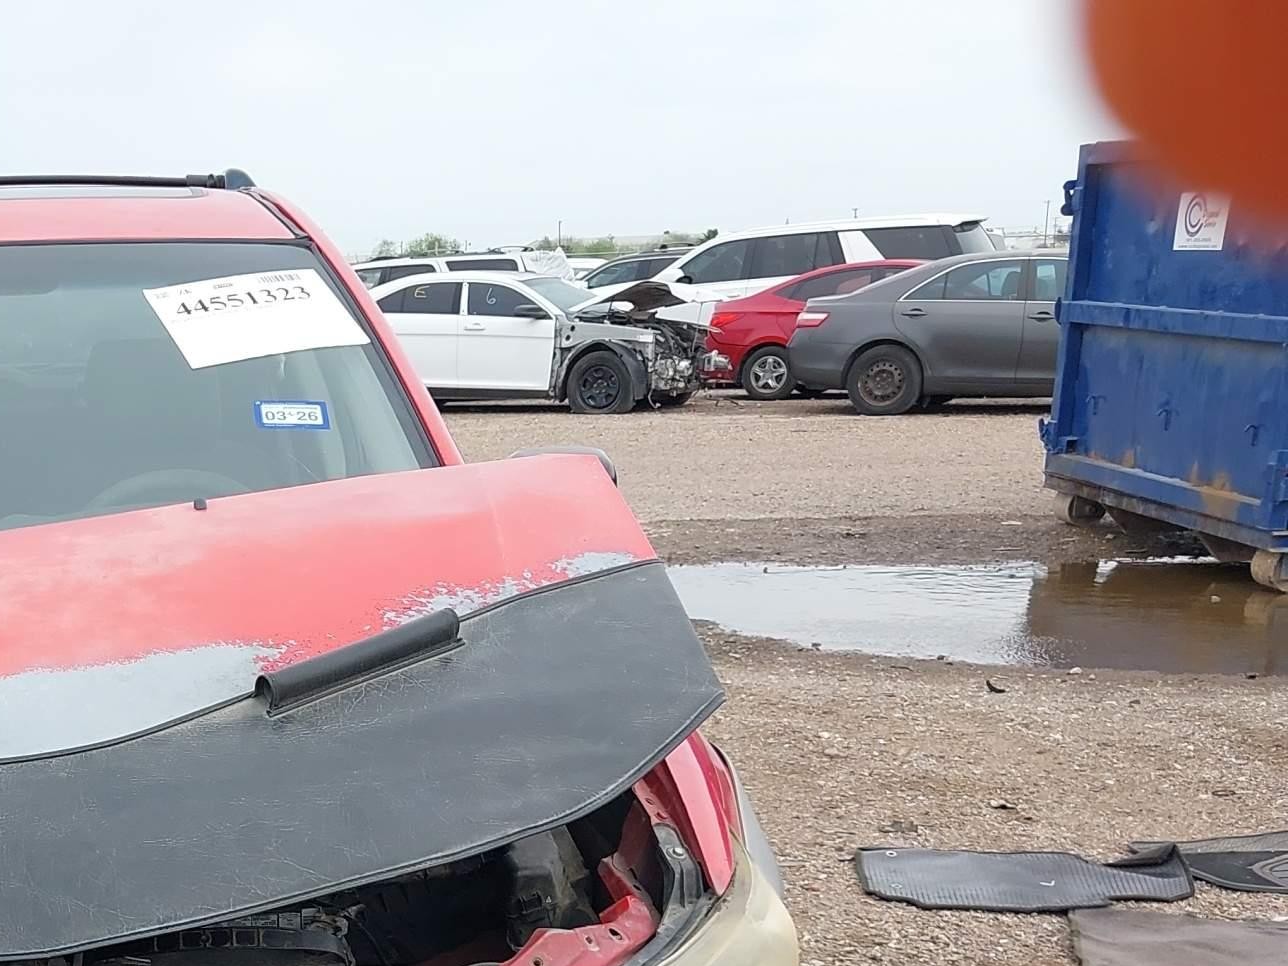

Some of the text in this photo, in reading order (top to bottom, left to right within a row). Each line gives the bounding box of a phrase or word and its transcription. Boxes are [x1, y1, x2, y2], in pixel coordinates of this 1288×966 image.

[414, 285, 430, 298] E
[486, 287, 497, 305] 6
[176, 286, 311, 315] 44551323
[265, 410, 319, 421] 03 26
